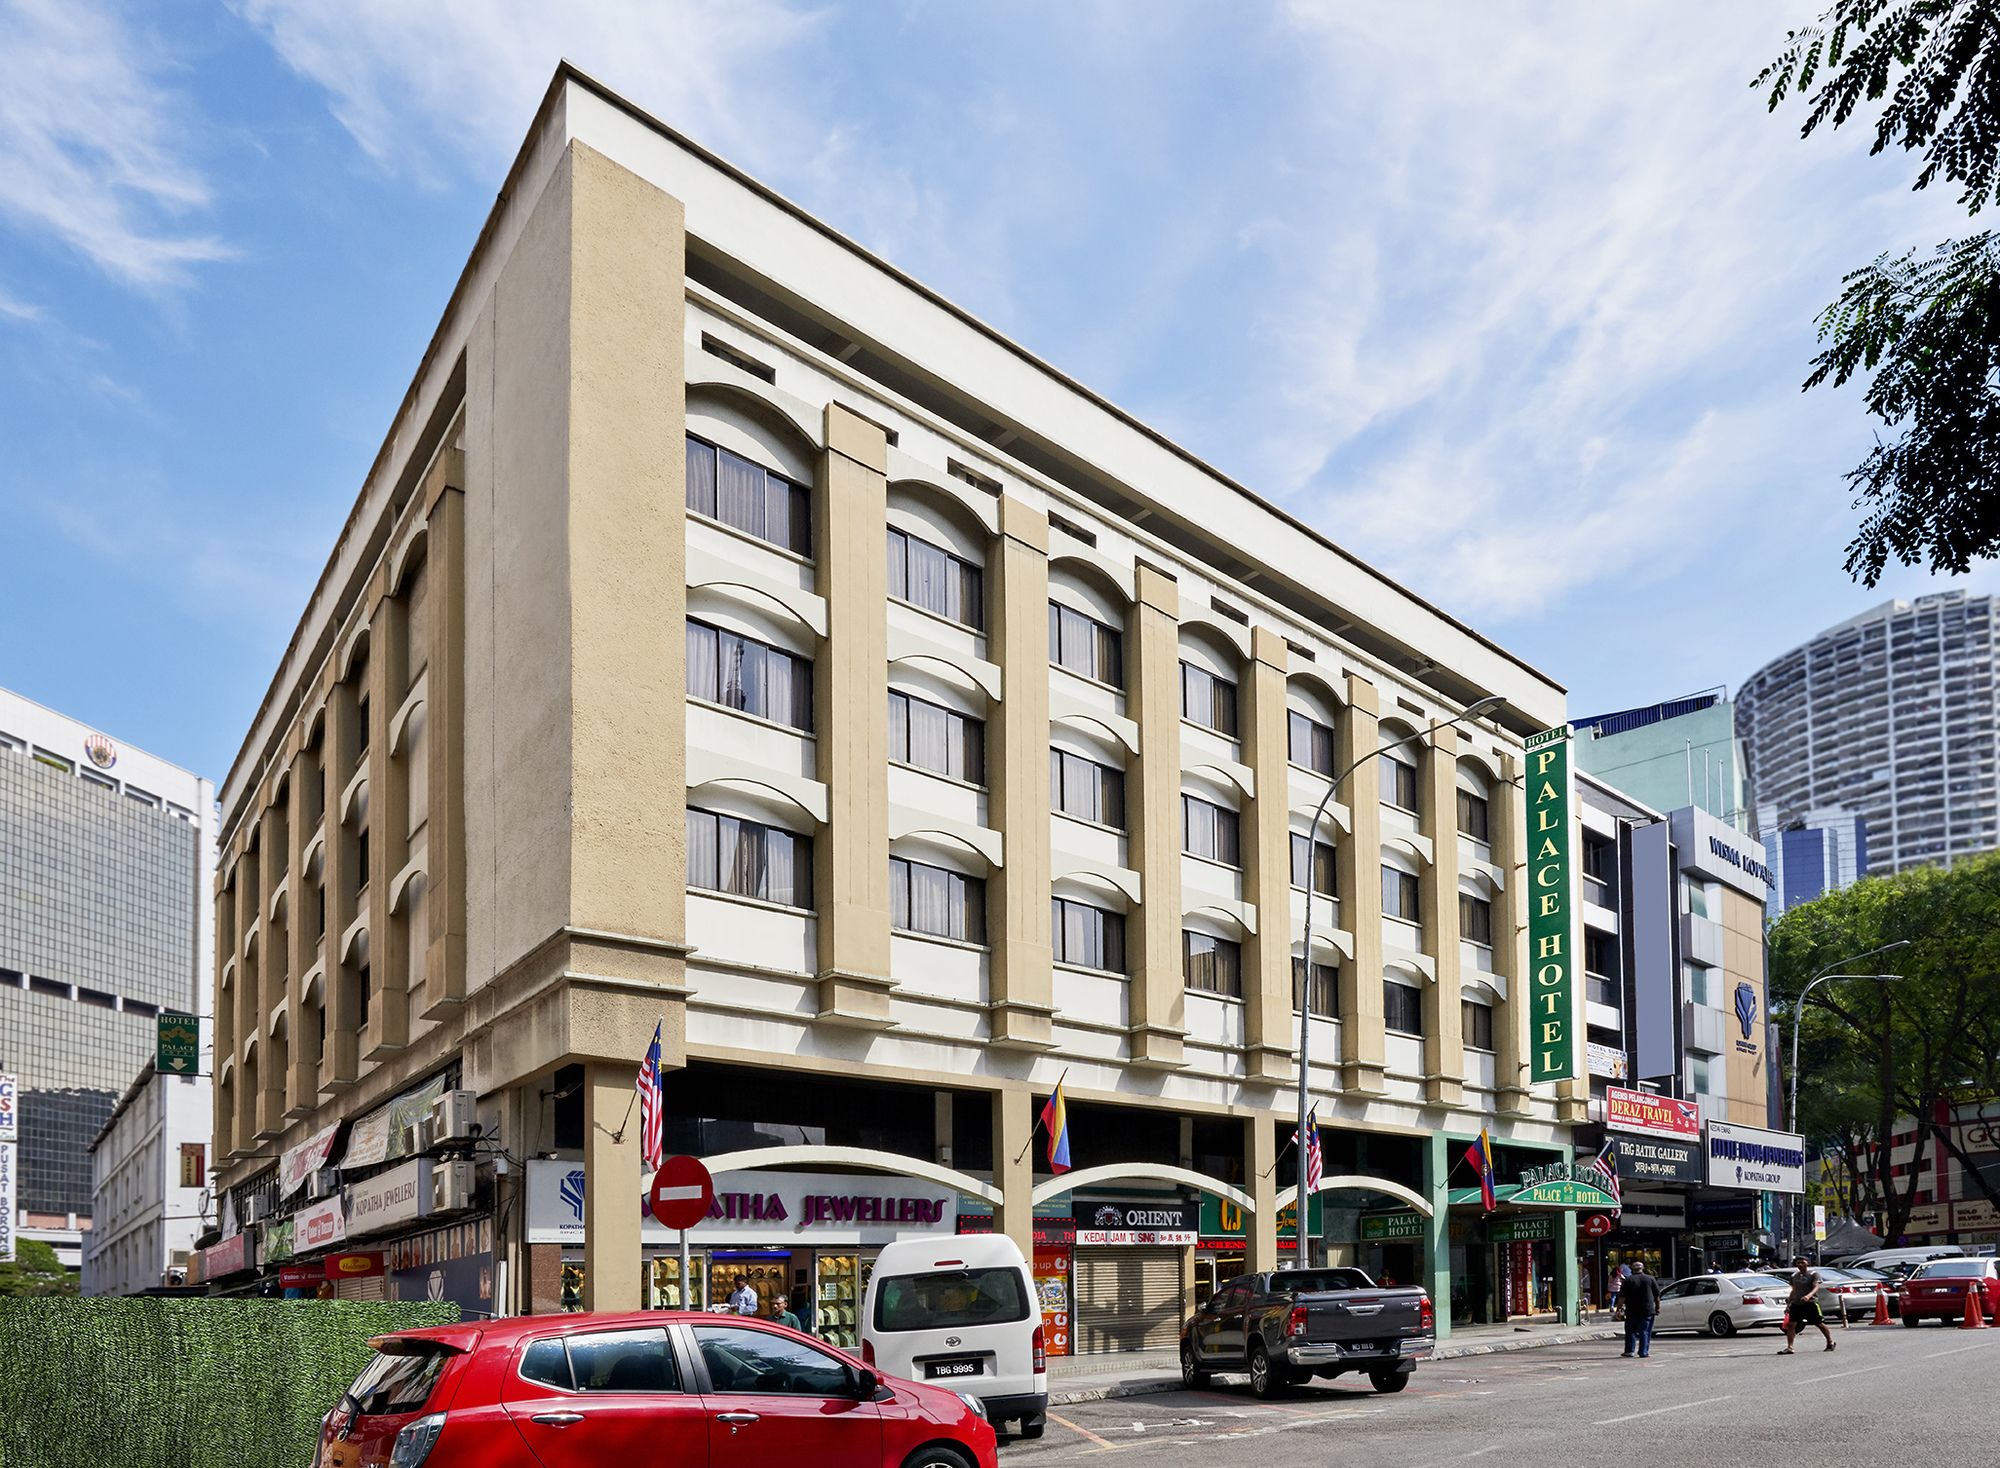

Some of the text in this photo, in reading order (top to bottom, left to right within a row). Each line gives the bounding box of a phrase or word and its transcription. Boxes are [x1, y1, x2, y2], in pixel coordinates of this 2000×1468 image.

[1528, 727, 1566, 747] HOTEL
[1709, 836, 1740, 868] WISMA
[1536, 751, 1563, 1073] PALACE HOTEL
[160, 1017, 197, 1025] HOTEL
[1611, 1100, 1673, 1123] DERAZ TRAVEL
[1620, 1142, 1688, 1162] TRG BATIK GALLERY
[1762, 1145, 1803, 1168] JEWELLERS
[1521, 1162, 1572, 1190] PALACE
[1765, 1173, 1780, 1183] GROUP
[356, 1180, 416, 1217] KOPATHA JEWELLERS
[1533, 1188, 1601, 1204] PALACE HOTEL
[800, 1195, 947, 1228] JEWELLERS
[1126, 1210, 1182, 1226] ORIENT
[1388, 1226, 1424, 1236] HOTEL
[1513, 1220, 1549, 1230] PALACE
[1514, 1229, 1549, 1239] HOTEL
[1084, 1232, 1107, 1243] KEDAI
[1111, 1233, 1126, 1243] JAM
[1138, 1233, 1155, 1243] SING
[936, 1364, 974, 1375] TBG 9995
